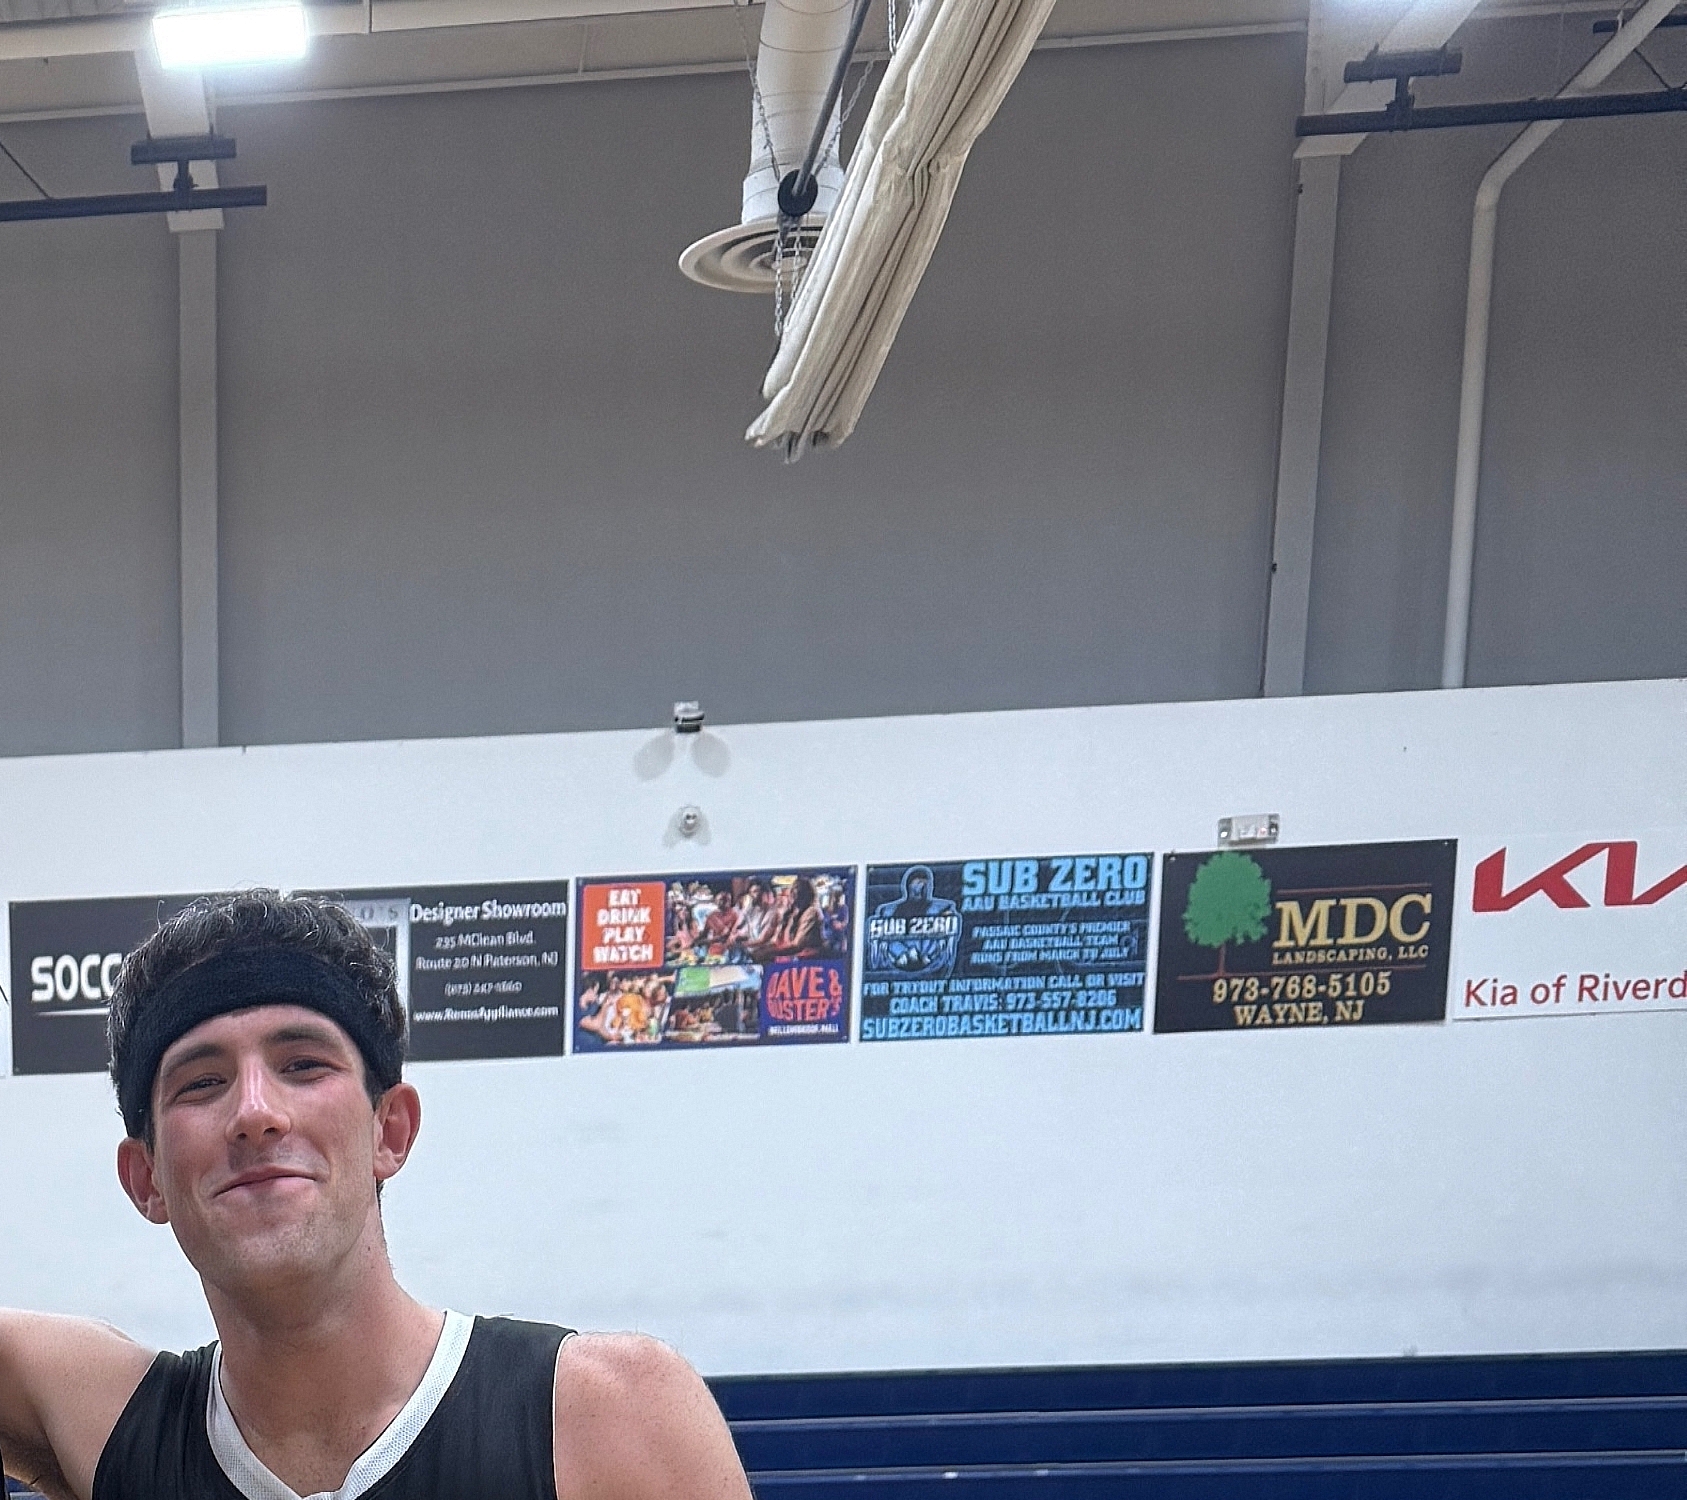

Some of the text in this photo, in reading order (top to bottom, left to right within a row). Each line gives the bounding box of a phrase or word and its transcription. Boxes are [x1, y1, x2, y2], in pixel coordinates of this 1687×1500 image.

[962, 855, 1148, 895] SUB ZERO
[607, 888, 642, 907] EAT
[961, 890, 1145, 912] AAU BASKETBALL CLUB
[411, 899, 566, 927] Designer Showroom
[597, 907, 651, 926] DRINK
[1273, 893, 1432, 948] MDC
[602, 927, 646, 944] PLAY
[870, 915, 958, 938] SUB ZERO
[593, 944, 653, 963] WATCH
[1009, 936, 1083, 949] BASKETBALL
[1004, 950, 1037, 963] FROM
[1272, 945, 1429, 966] LANDSCAPING, LLC
[31, 953, 123, 1003] SOCC
[863, 982, 889, 996] FOR
[949, 976, 1046, 993] INFORMATION
[1047, 974, 1083, 988] CALL
[1085, 973, 1105, 987] OR
[1108, 972, 1144, 987] VISIT
[1213, 971, 1392, 1004] 973-768-5105
[1465, 970, 1687, 1008] Kia of Riverd
[889, 996, 938, 1014] COACH
[1233, 1000, 1365, 1026] WAYNE, NJ
[862, 1008, 1143, 1039] SUBZEROBASKETBALLNJ.COM
